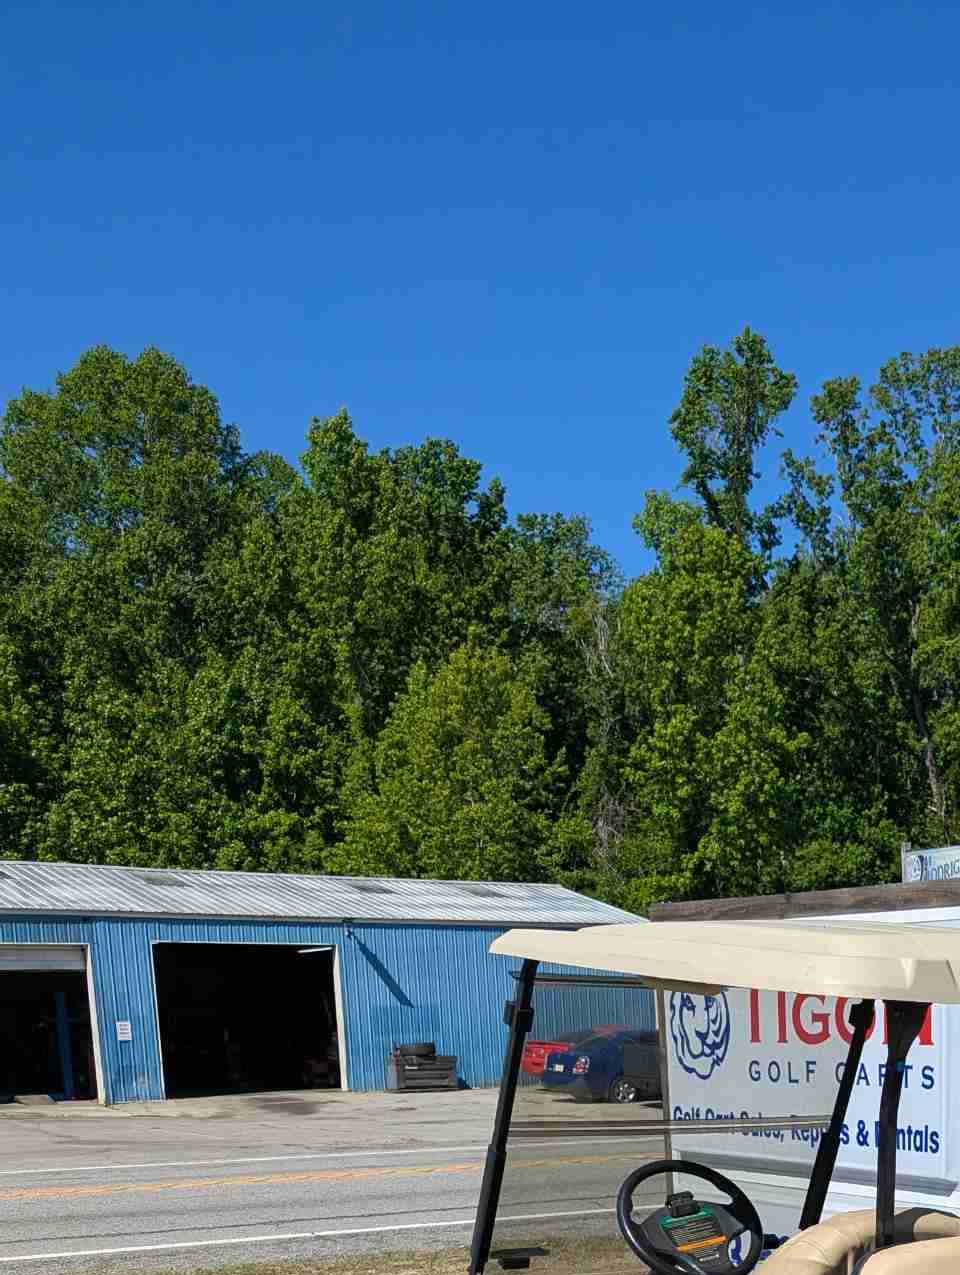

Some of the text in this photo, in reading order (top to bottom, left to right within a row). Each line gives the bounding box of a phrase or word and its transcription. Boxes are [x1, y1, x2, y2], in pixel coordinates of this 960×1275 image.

[748, 1059, 936, 1090] GOLF CARTS
[791, 1114, 850, 1148] Reps
[856, 1119, 870, 1147] &
[875, 1120, 940, 1154] ntals
